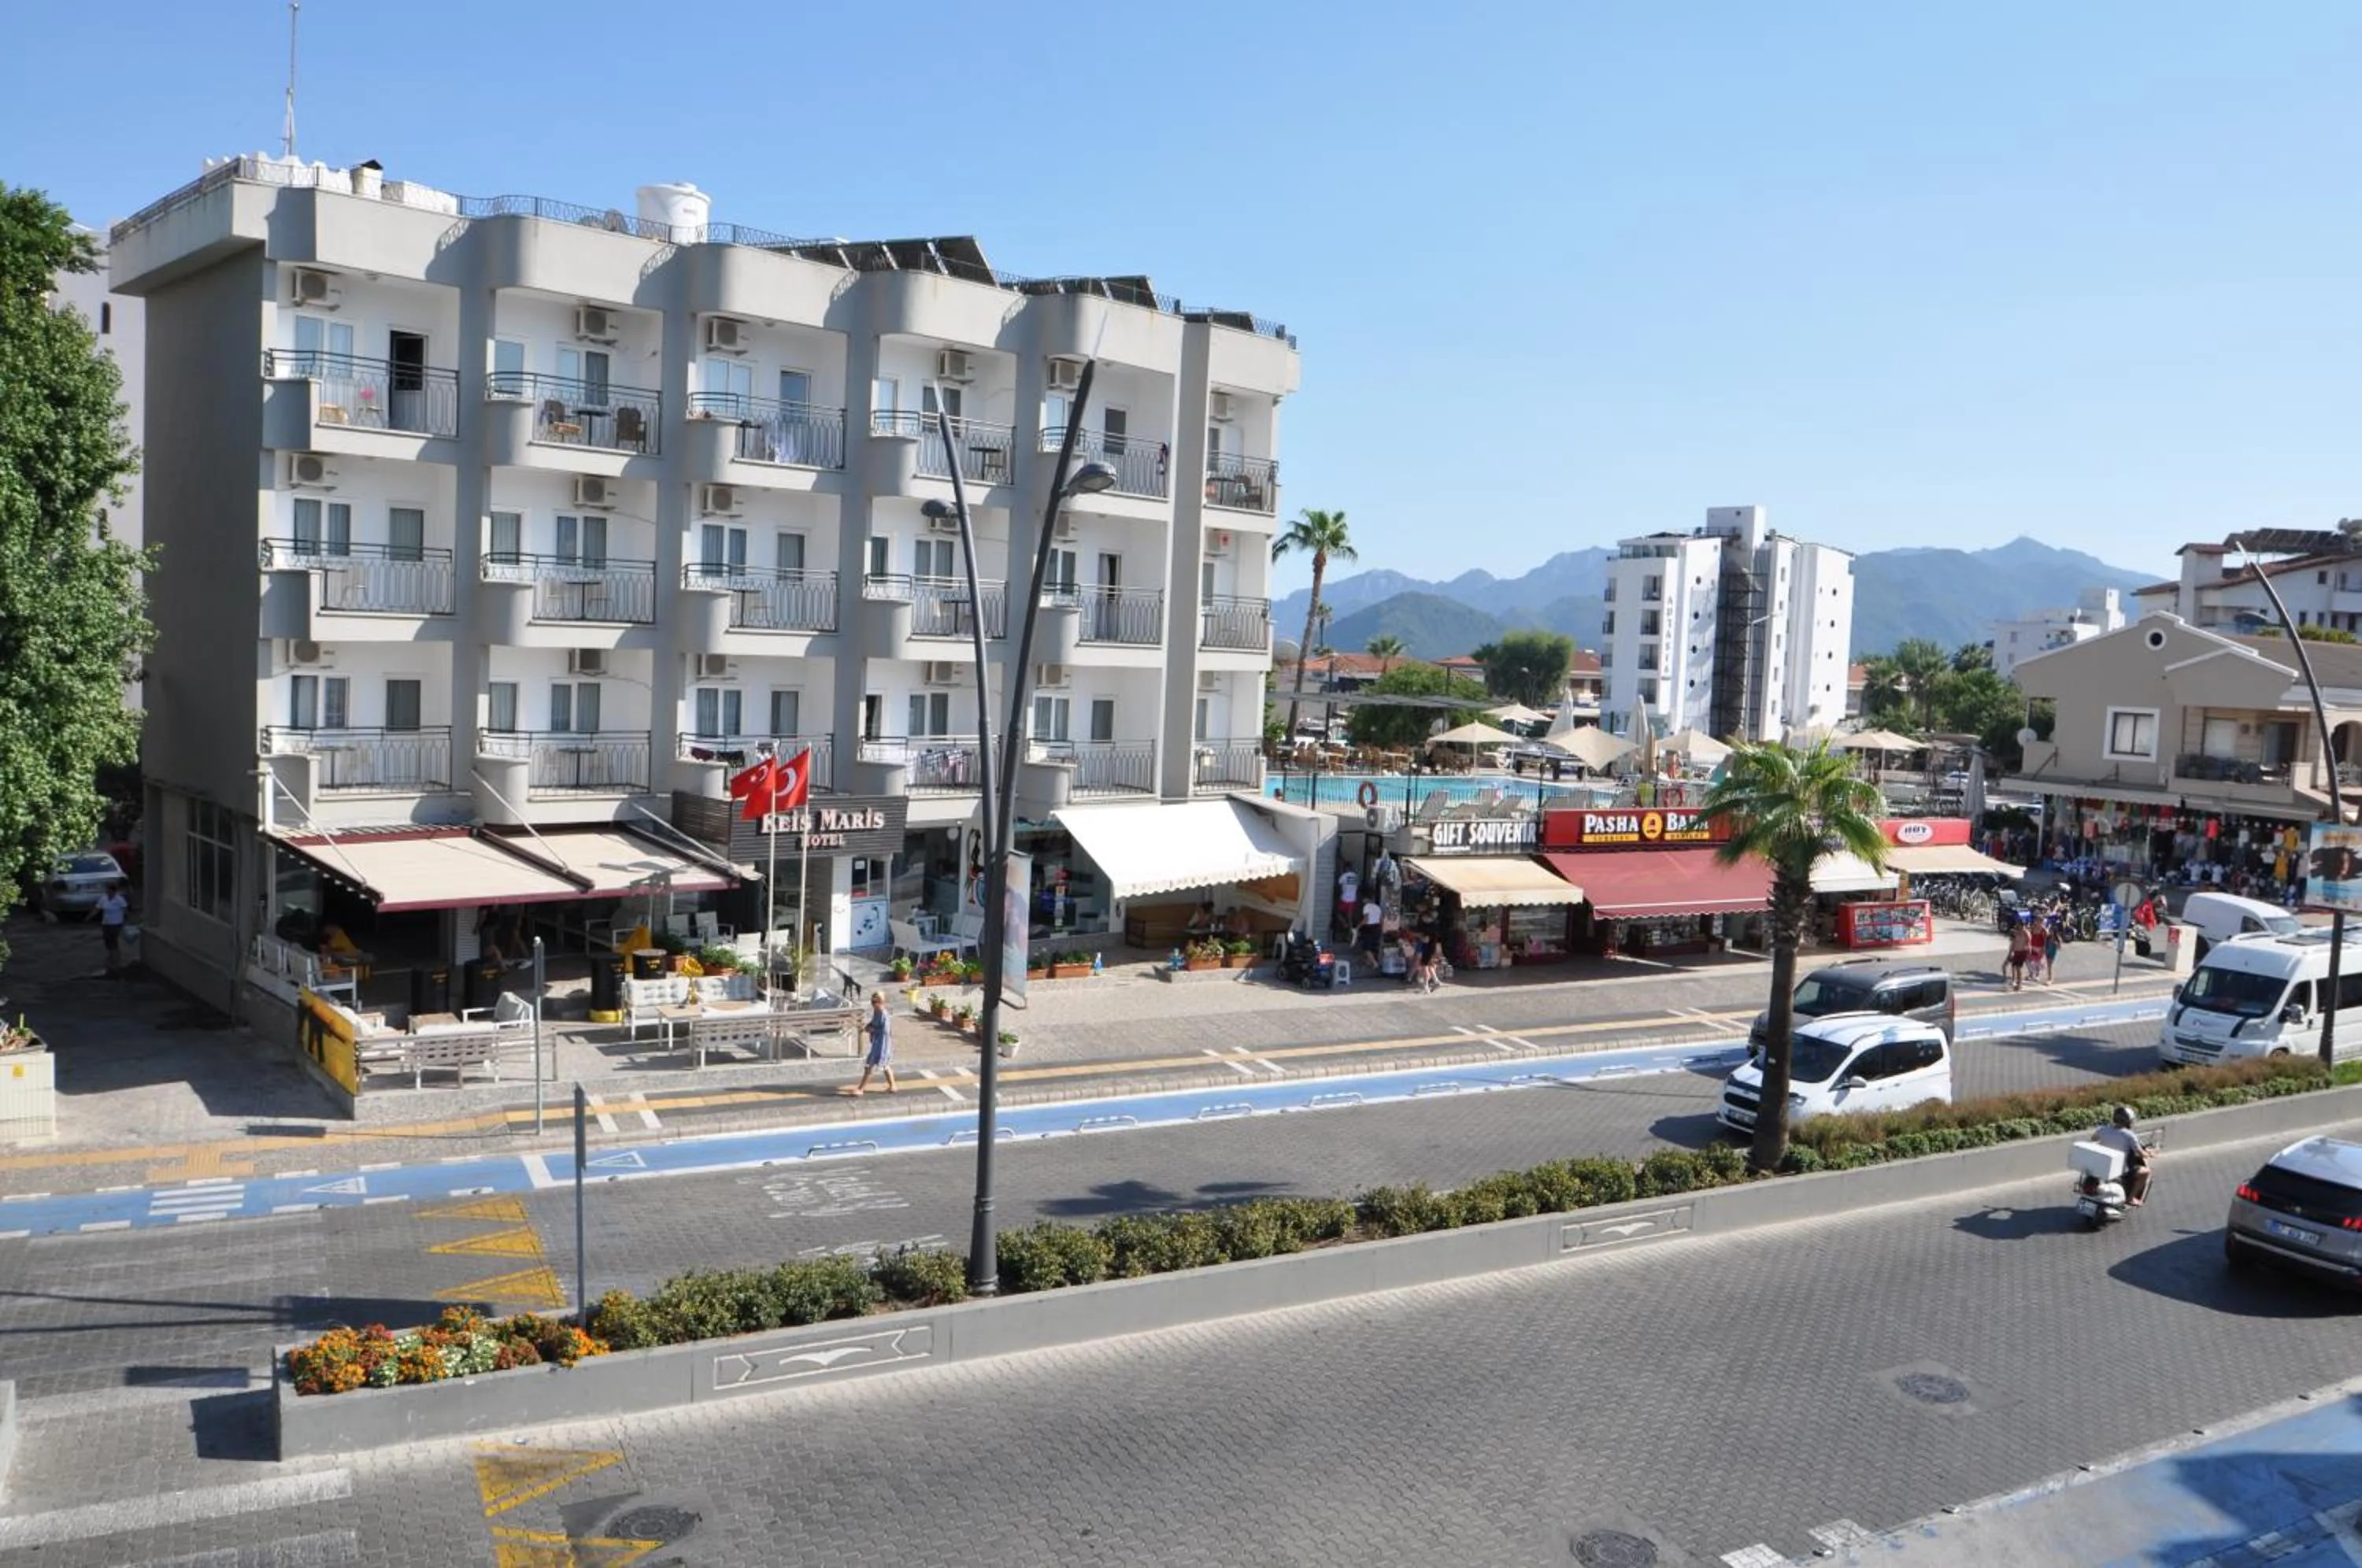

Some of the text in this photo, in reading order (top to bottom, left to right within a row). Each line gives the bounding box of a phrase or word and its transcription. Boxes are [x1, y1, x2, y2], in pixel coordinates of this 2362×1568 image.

[1434, 822, 1537, 845] GIFT SOUVENIR
[1584, 814, 1639, 834] PASHA
